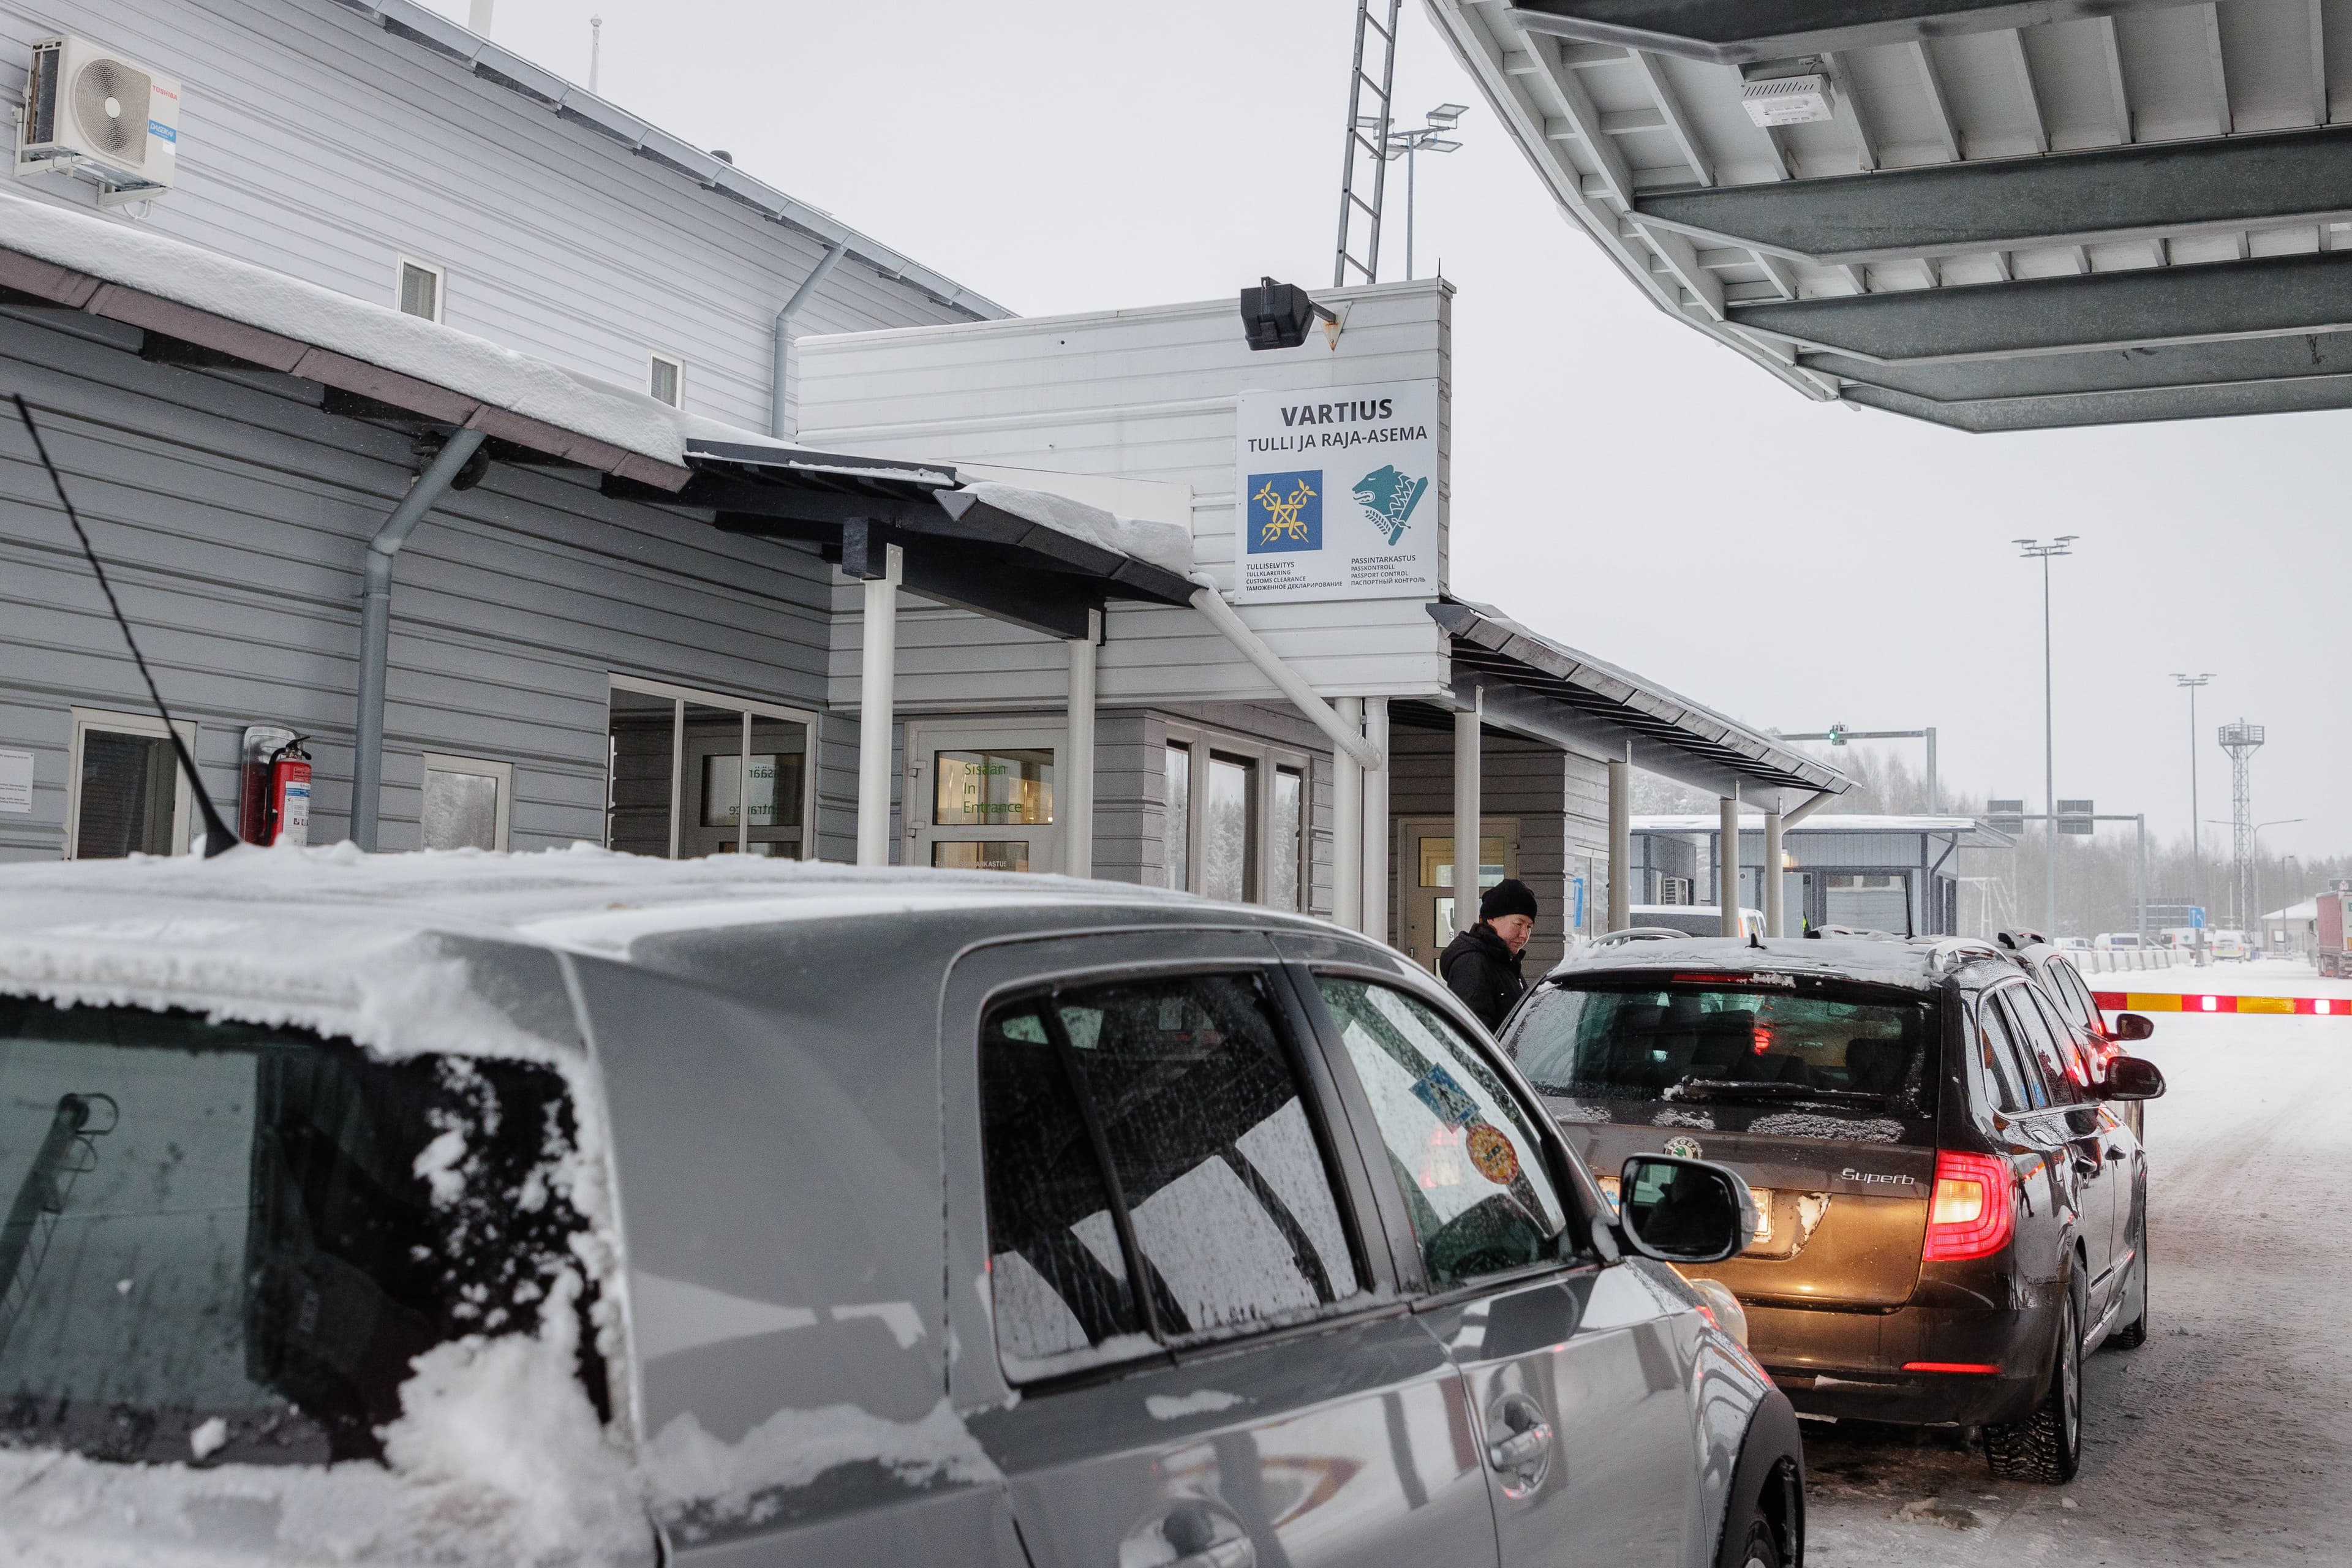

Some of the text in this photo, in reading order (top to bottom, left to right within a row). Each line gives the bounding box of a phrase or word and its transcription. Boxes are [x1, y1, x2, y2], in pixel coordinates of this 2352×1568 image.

[152, 85, 178, 100] TOSHIBA
[1281, 399, 1393, 427] VARTIUS
[1248, 425, 1428, 452] TULLI JA RAJA-ASEMA
[1351, 554, 1416, 564] PASSINTARKASTUS
[1246, 562, 1295, 570] TULLISELVITYS
[1287, 581, 1343, 590] ДЕКЛАРИРОВАНИЕ
[1351, 578, 1393, 586] ПАСПОРТНЫЙ
[965, 763, 1006, 775] Sisään
[964, 782, 976, 794] In
[963, 801, 1022, 814] Entrance
[1841, 1167, 1915, 1185] Superb
